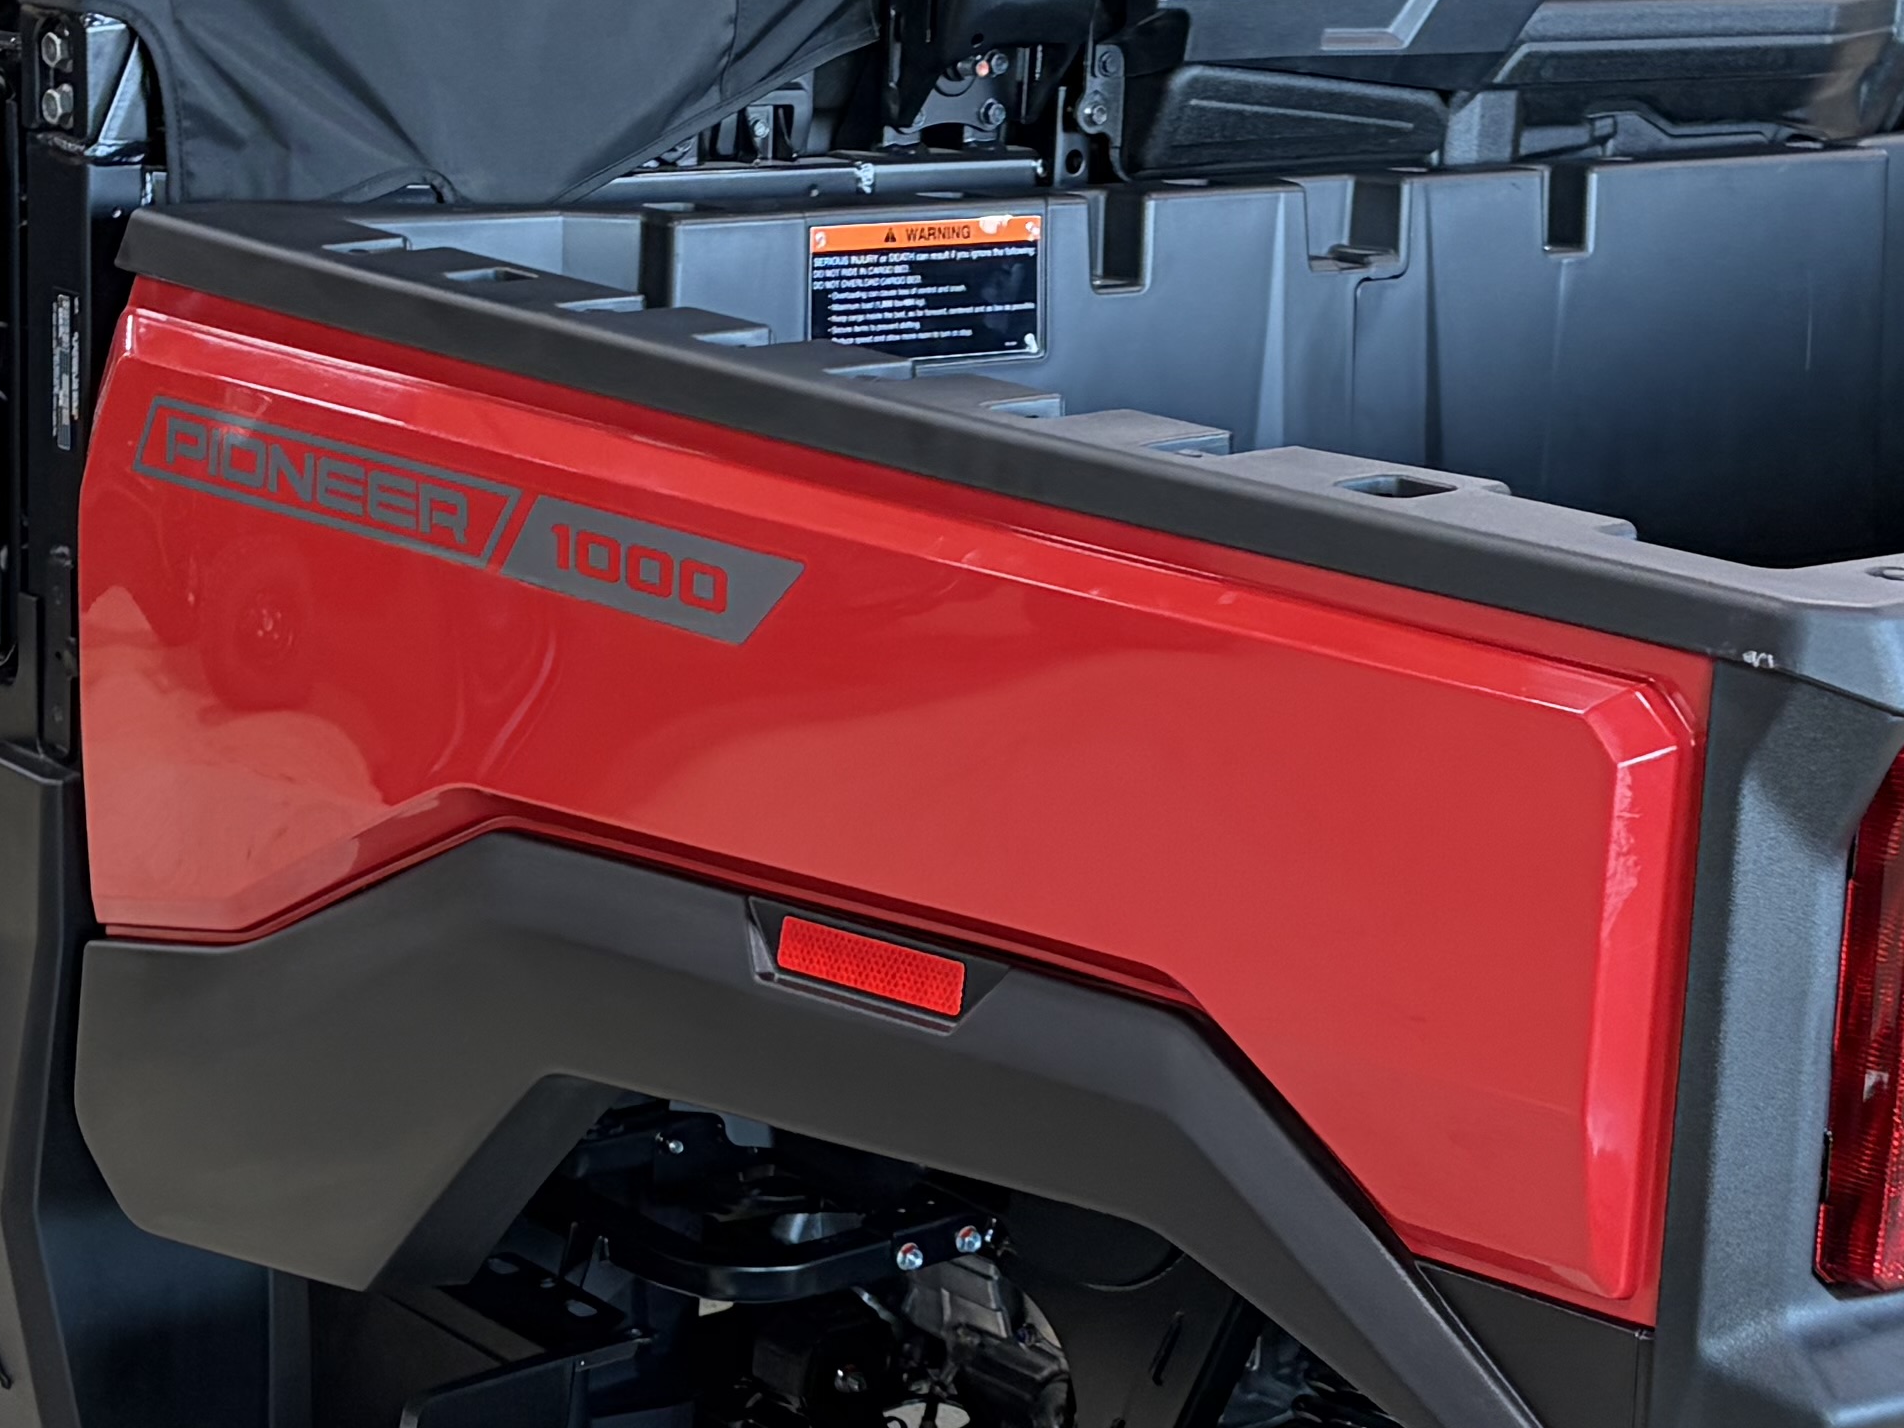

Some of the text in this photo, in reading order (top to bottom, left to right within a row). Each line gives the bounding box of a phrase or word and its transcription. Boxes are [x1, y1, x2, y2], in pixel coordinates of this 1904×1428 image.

[905, 225, 971, 241] WARNING
[166, 416, 729, 614] PIONEER 1000
